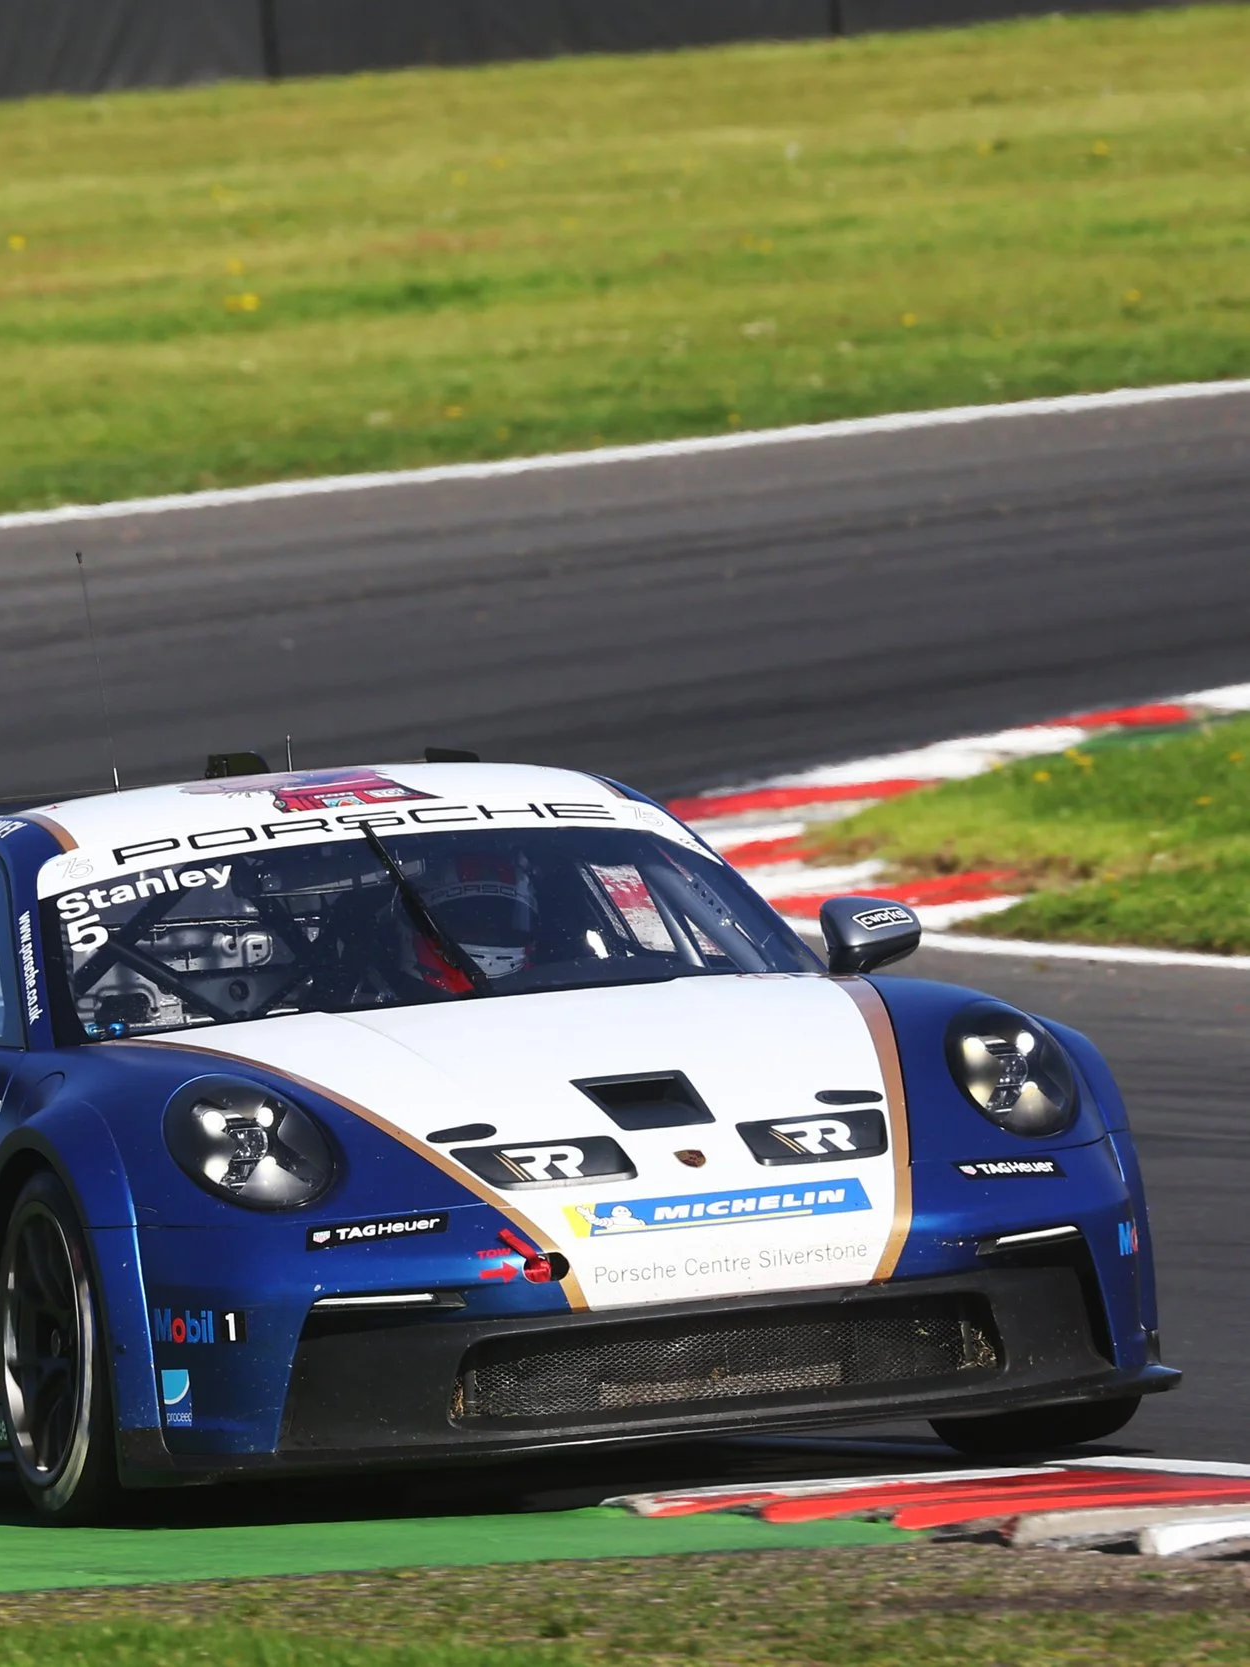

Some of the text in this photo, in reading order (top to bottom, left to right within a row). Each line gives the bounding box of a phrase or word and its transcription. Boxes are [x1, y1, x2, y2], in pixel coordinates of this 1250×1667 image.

[113, 802, 616, 866] PORSCHE
[56, 857, 94, 880] 75
[56, 865, 232, 920] Stanley
[66, 914, 109, 952] 5
[860, 909, 908, 925] cworks
[18, 910, 44, 1025] www.porsche.co.uk
[653, 1188, 846, 1221] MICHELIN
[476, 1247, 512, 1260] TOW
[594, 1242, 868, 1284] Porsche Centre Silverstone
[153, 1307, 236, 1344] Mobil 1
